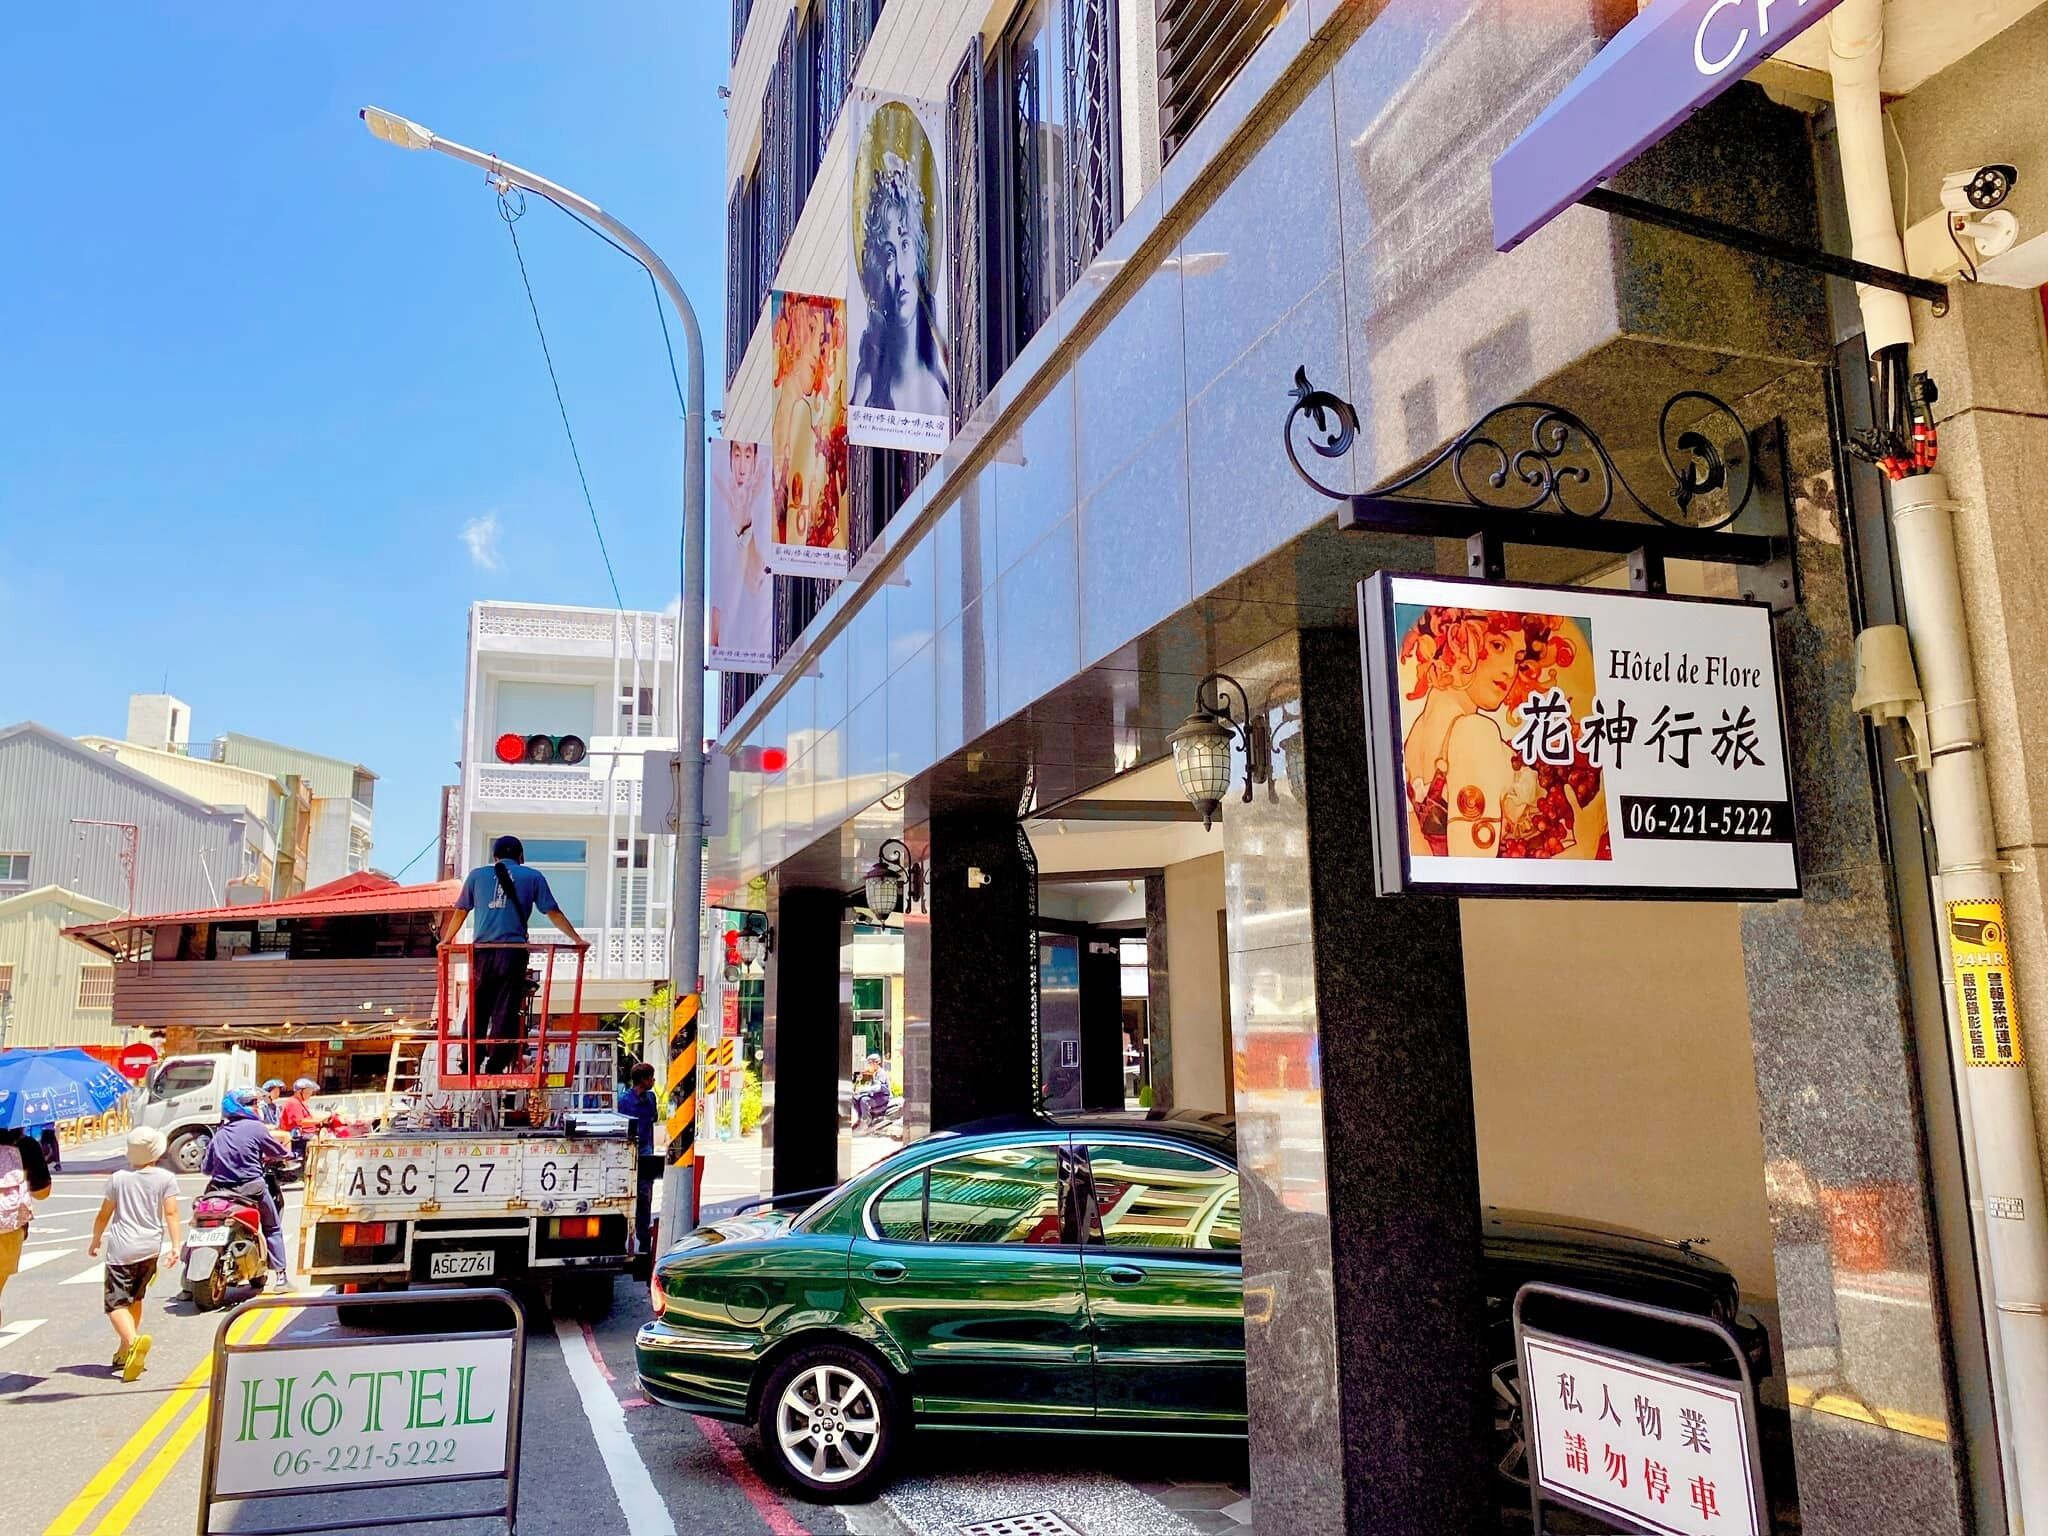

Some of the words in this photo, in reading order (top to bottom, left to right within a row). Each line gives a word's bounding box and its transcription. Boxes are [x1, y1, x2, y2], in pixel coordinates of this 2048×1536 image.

[1608, 648, 1671, 684] Hôtel
[1676, 653, 1699, 684] de
[1704, 655, 1762, 689] Flore
[1517, 690, 1767, 771] 花神行旅
[1628, 802, 1773, 837] 06-221-5222
[452, 1163, 496, 1195] 27
[540, 1161, 580, 1193] 61
[432, 1256, 491, 1275] ASC-2761
[1556, 1371, 1712, 1455] 私人物業
[273, 1438, 458, 1477] 06-221-5222
[1563, 1429, 1721, 1521] 請勿停車
